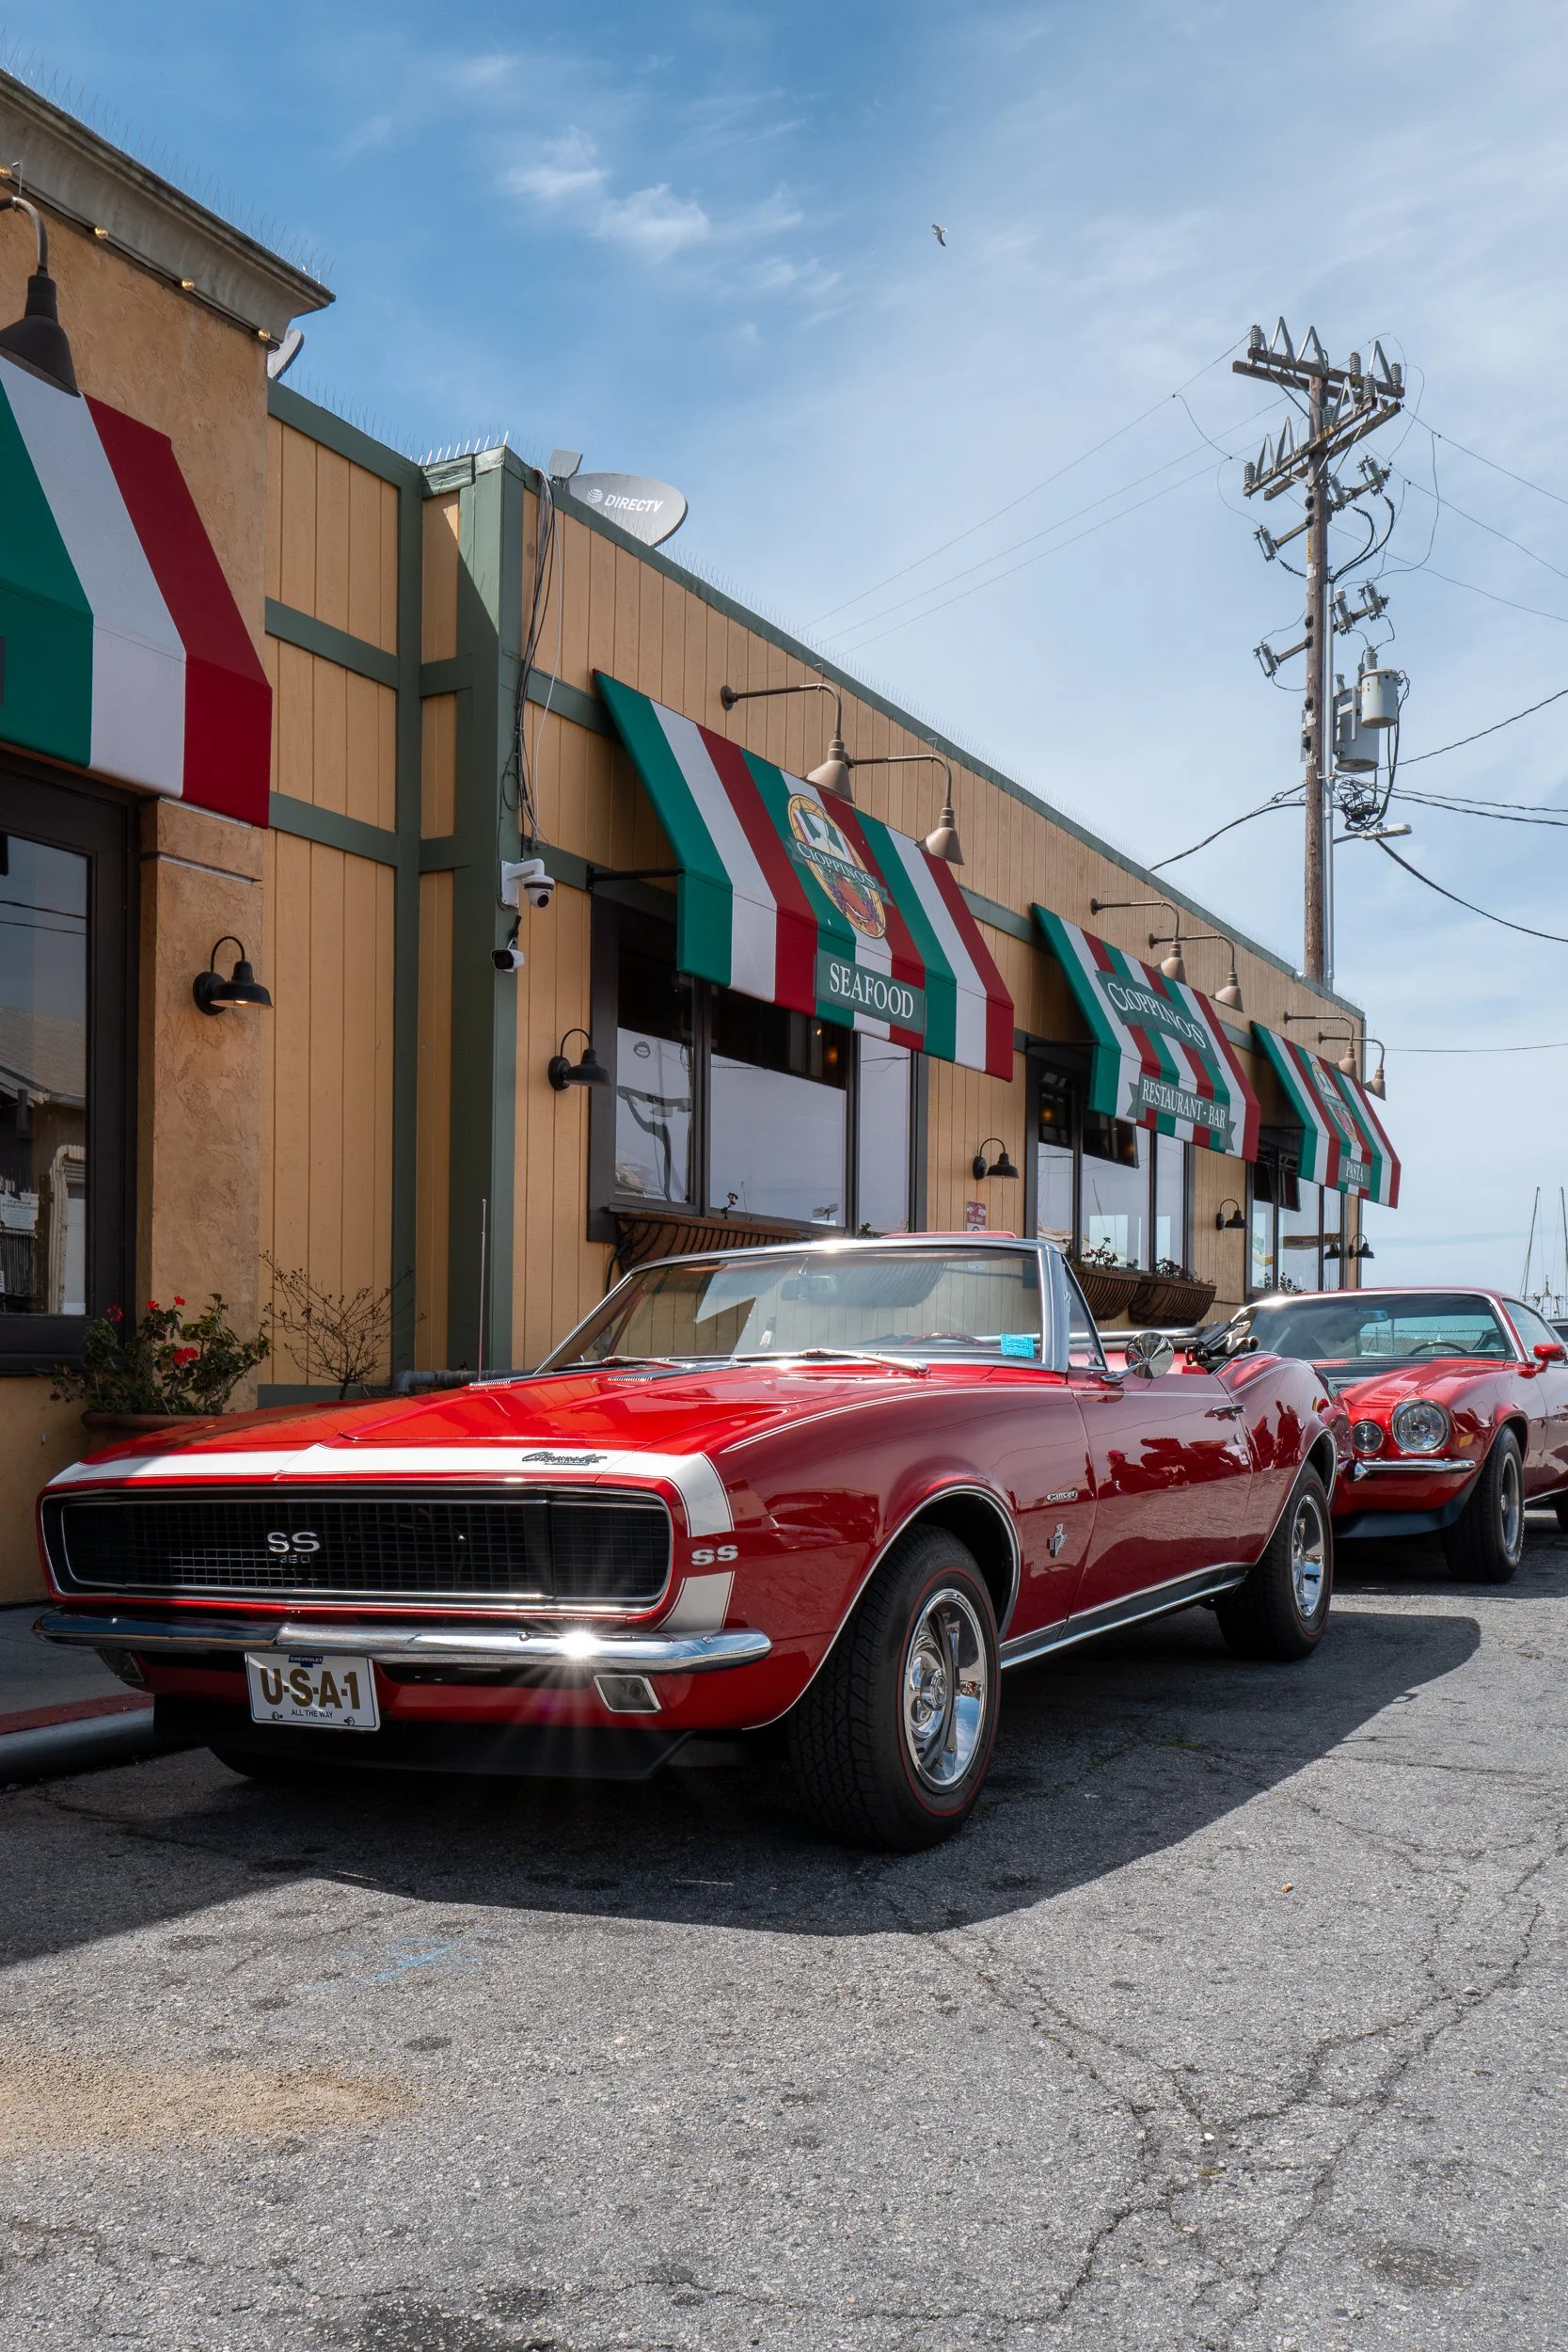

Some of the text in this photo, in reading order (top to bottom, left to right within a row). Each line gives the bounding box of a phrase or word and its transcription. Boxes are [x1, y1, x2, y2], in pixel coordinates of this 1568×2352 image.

[605, 494, 664, 512] DIRECTV
[796, 842, 877, 889] CIOPPINO'S
[830, 962, 914, 1019] SEAFOOD
[1107, 982, 1207, 1049] CIOPPINO'S
[1141, 1079, 1204, 1121] RESTAURANT
[1209, 1104, 1226, 1130] BAR
[1346, 1161, 1364, 1182] PASTA
[267, 1532, 321, 1552] SS
[691, 1544, 738, 1565] SS
[305, 1709, 318, 1718] THE
[319, 1710, 333, 1719] WAY
